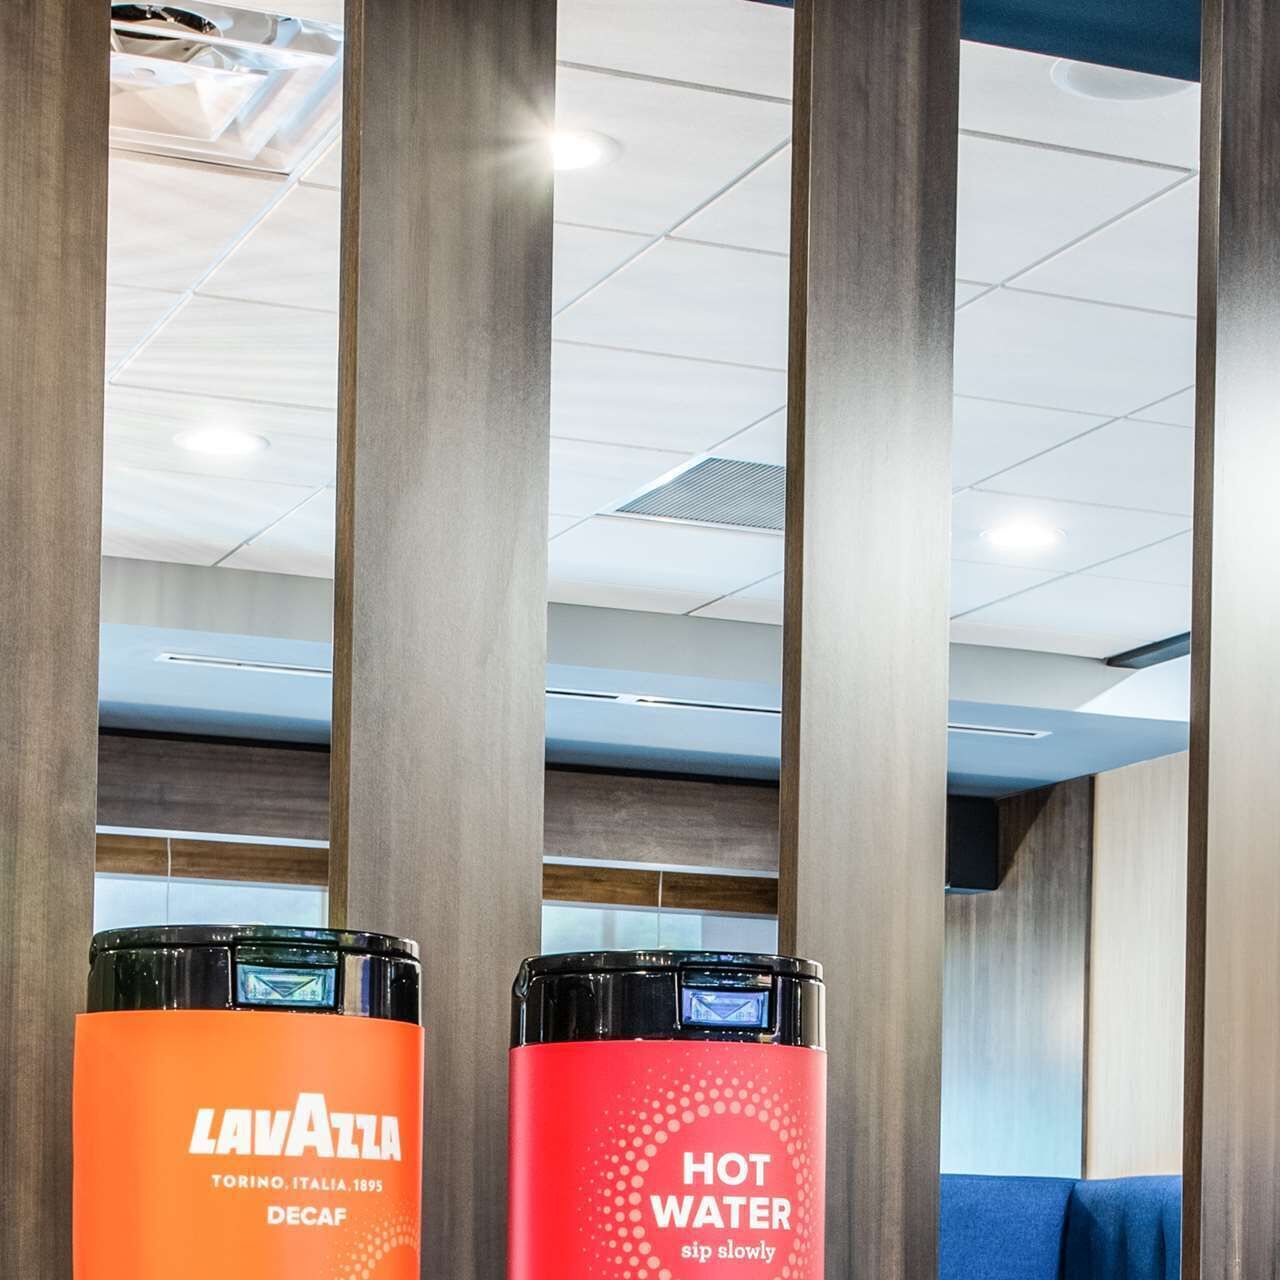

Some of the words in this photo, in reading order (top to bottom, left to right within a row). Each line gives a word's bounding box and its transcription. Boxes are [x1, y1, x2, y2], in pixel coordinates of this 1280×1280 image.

[188, 1092, 402, 1161] LAVAZZA
[683, 1152, 771, 1186] HOT
[353, 1179, 383, 1193] 1895
[267, 1206, 347, 1226] DECAF
[649, 1195, 792, 1230] WATER
[681, 1240, 713, 1263] sip
[717, 1239, 776, 1263] slowly
